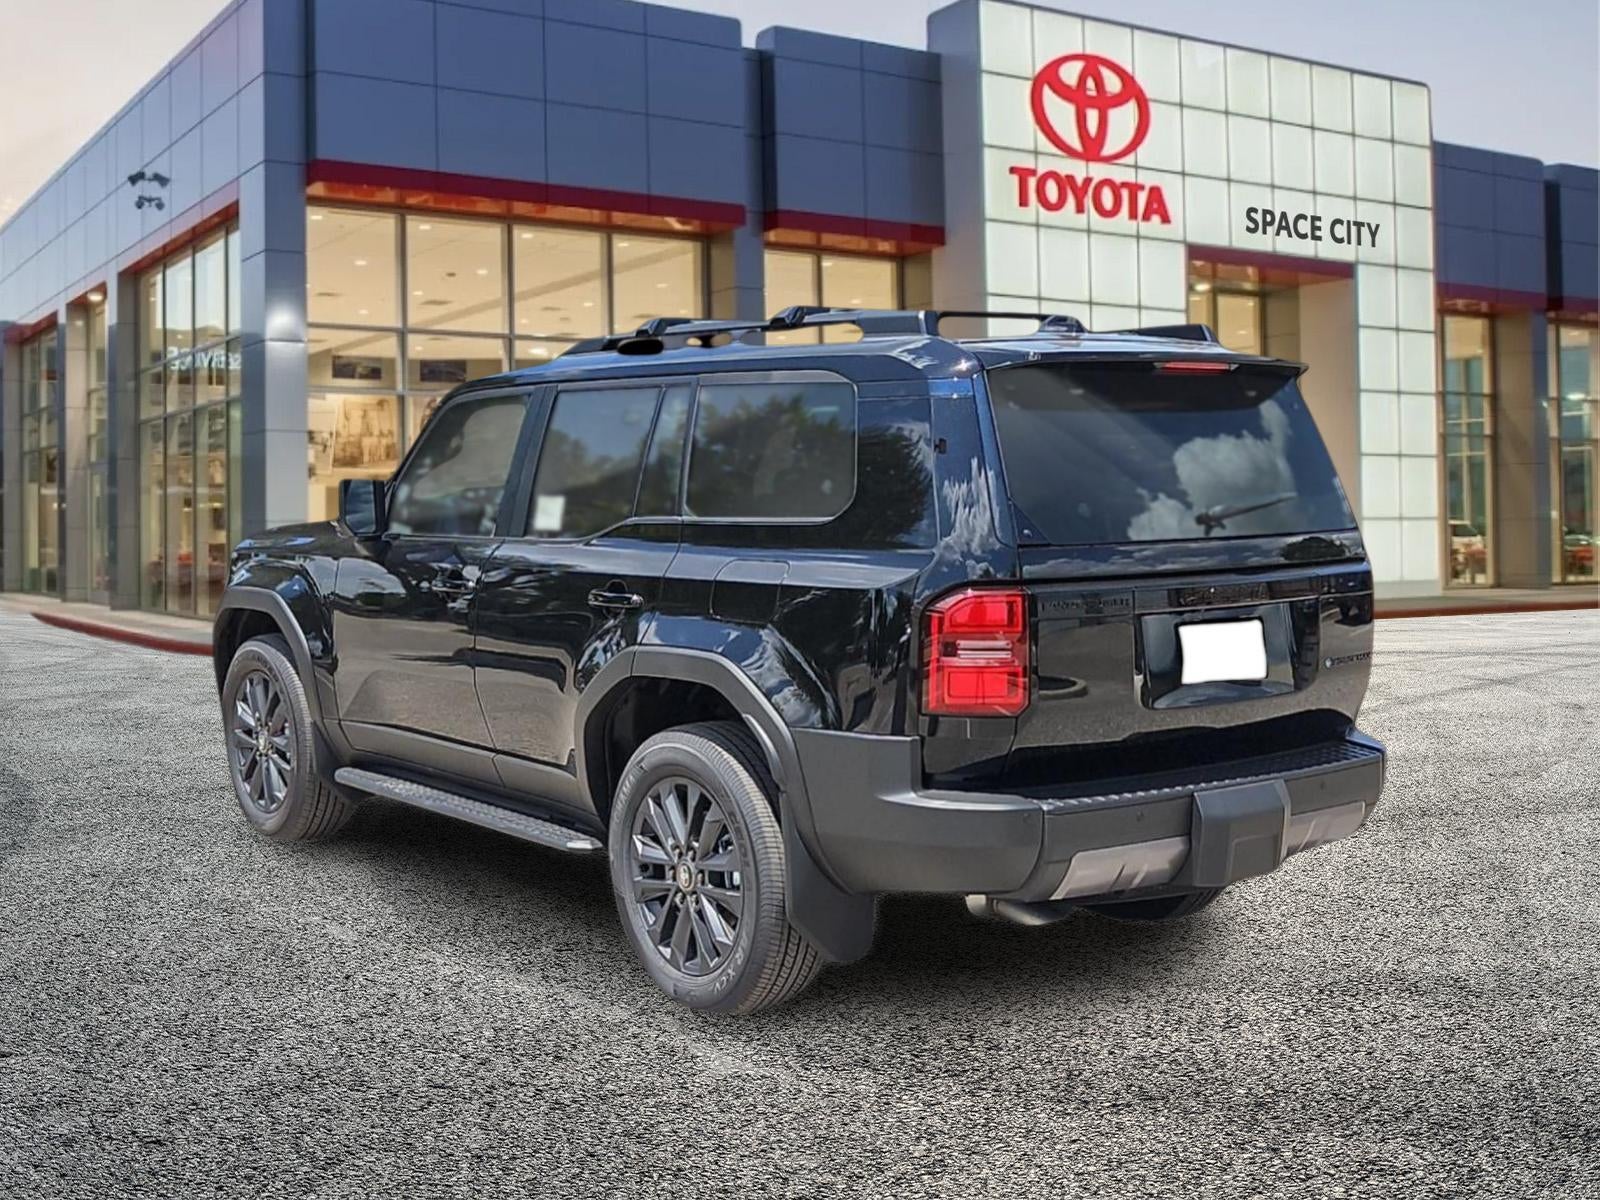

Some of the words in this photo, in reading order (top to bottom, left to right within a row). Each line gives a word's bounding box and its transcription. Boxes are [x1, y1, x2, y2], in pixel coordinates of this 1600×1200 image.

[1009, 167, 1171, 224] TOYOTA
[1245, 207, 1322, 242] SPACE
[1330, 219, 1380, 248] CITY
